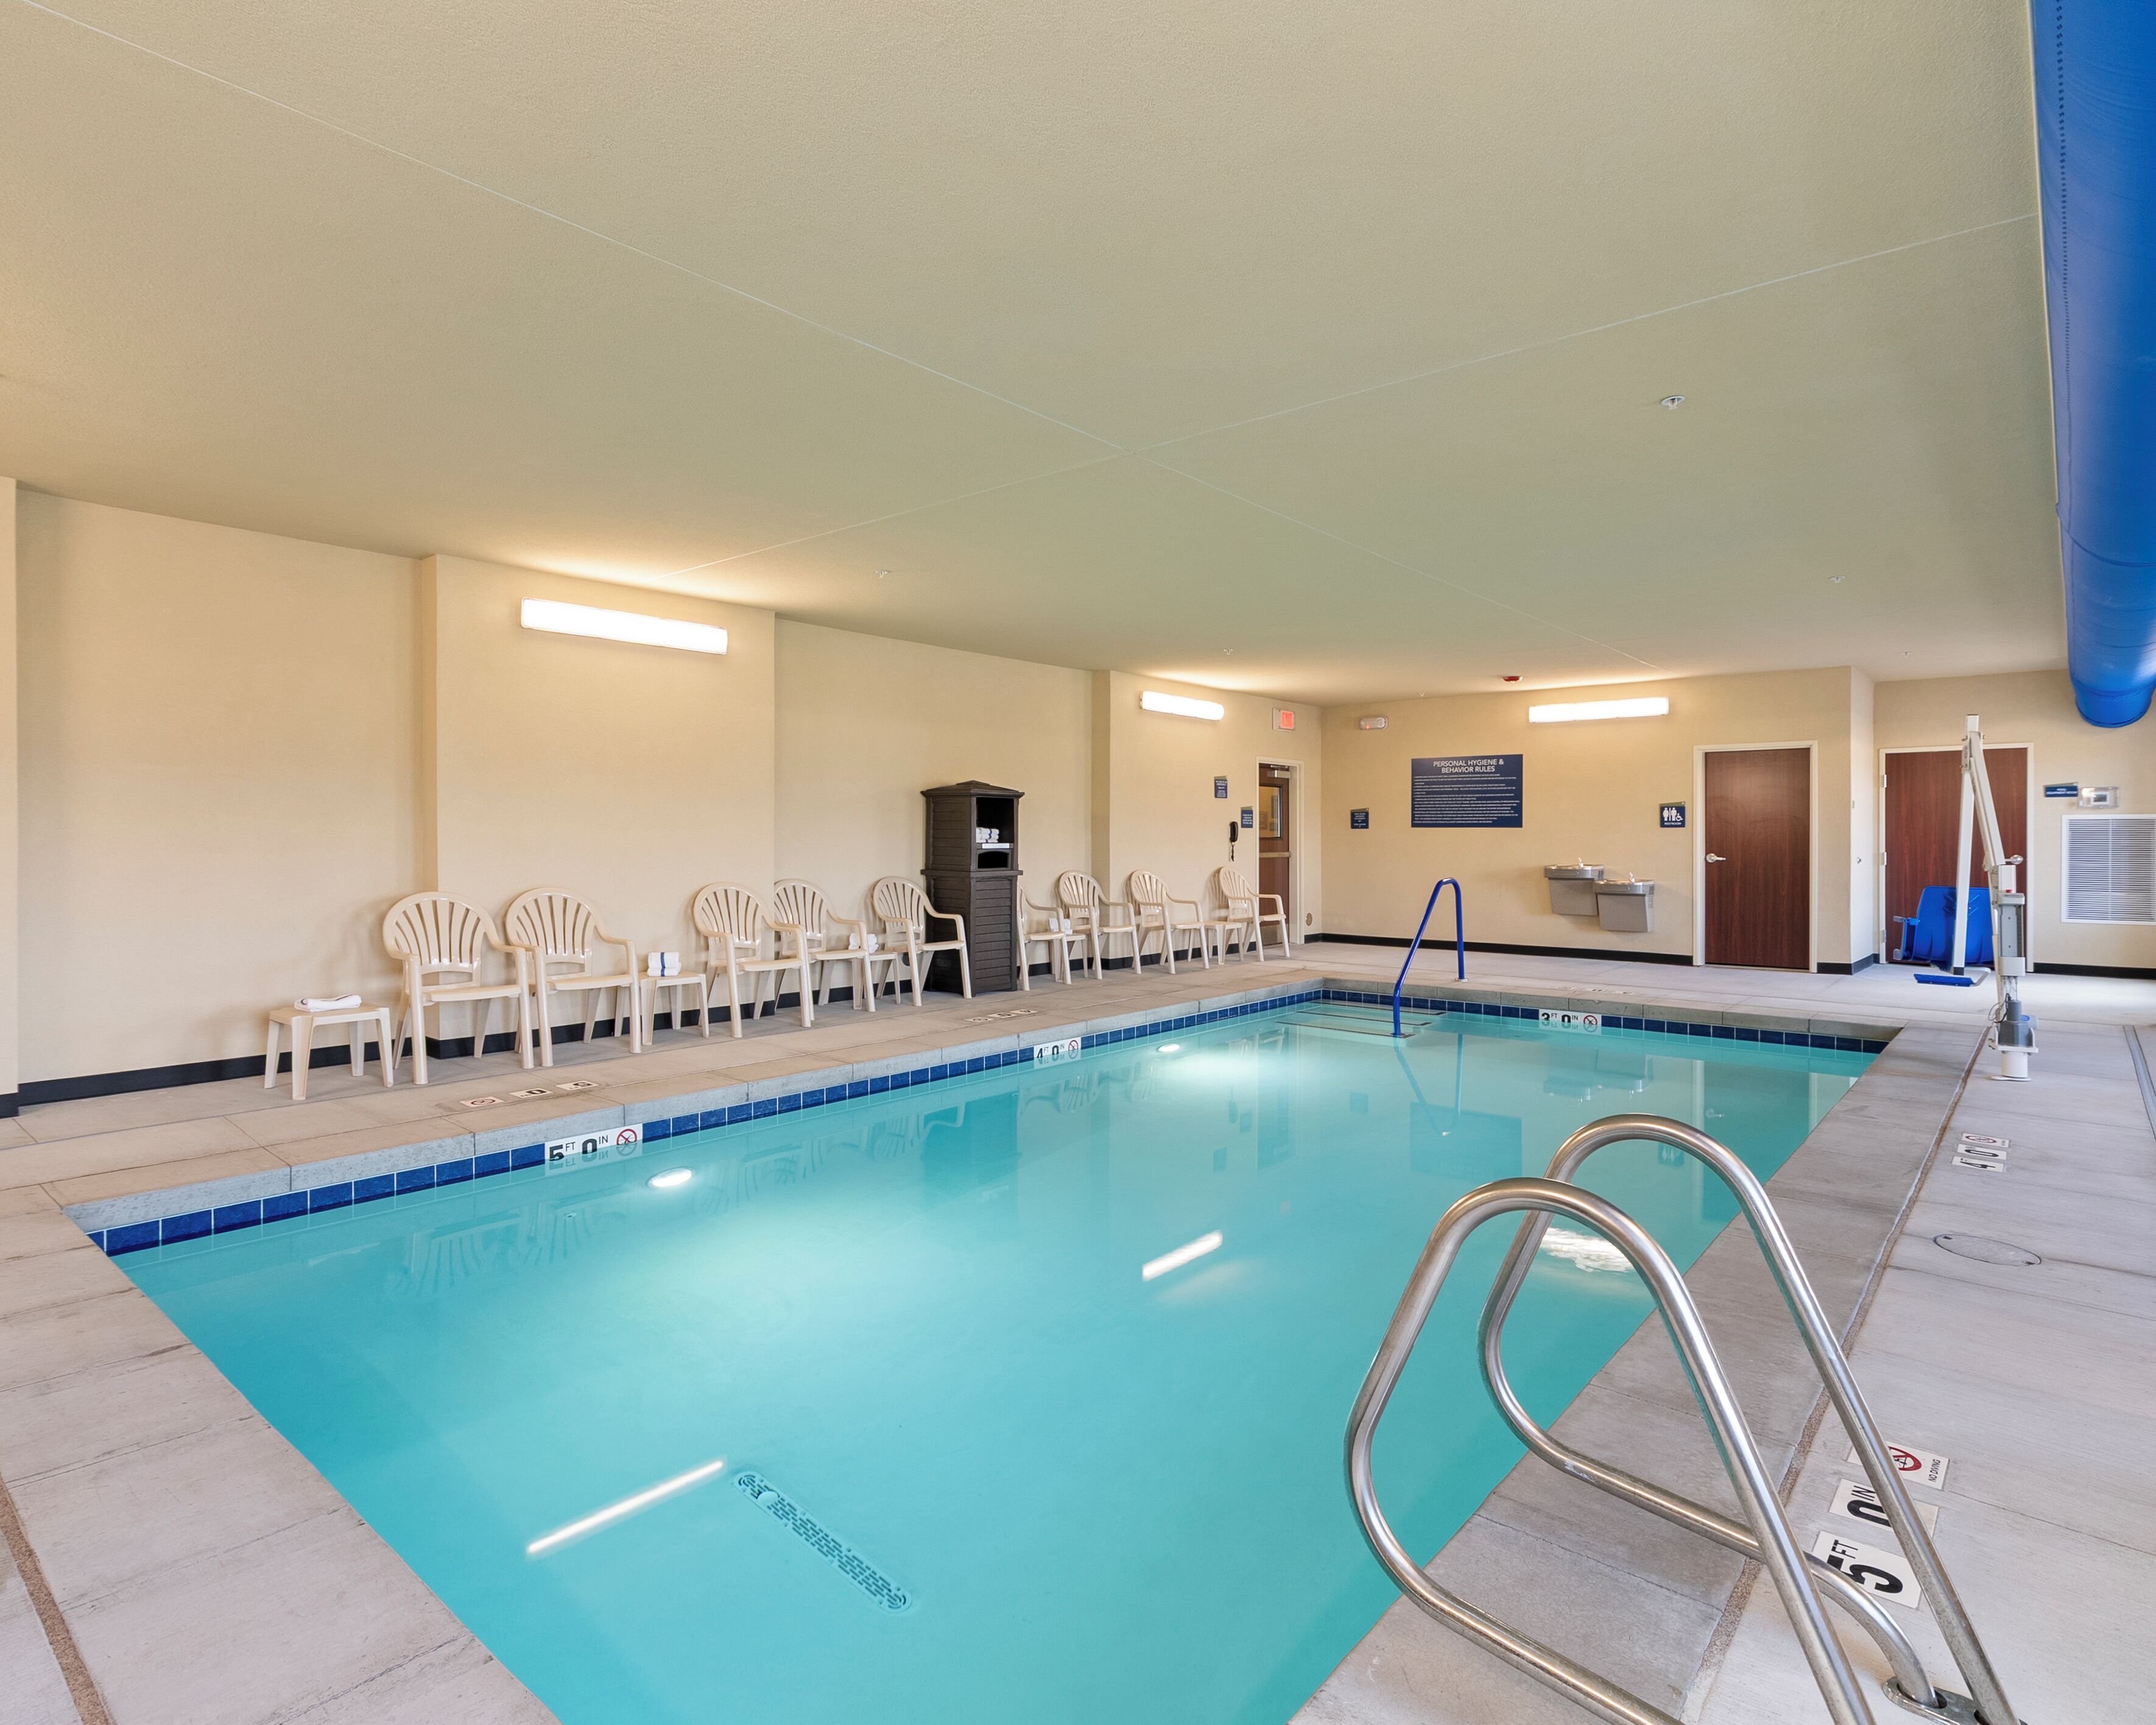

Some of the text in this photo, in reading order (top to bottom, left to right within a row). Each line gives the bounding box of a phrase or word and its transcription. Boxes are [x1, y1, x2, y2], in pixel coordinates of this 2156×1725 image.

[549, 1135, 608, 1161] 5 FT 0 IN
[1928, 1459, 1940, 1483] NO DIVING
[1851, 1485, 1876, 1501] IN
[1831, 1539, 1858, 1559] FT
[1827, 1554, 1903, 1593] 5
